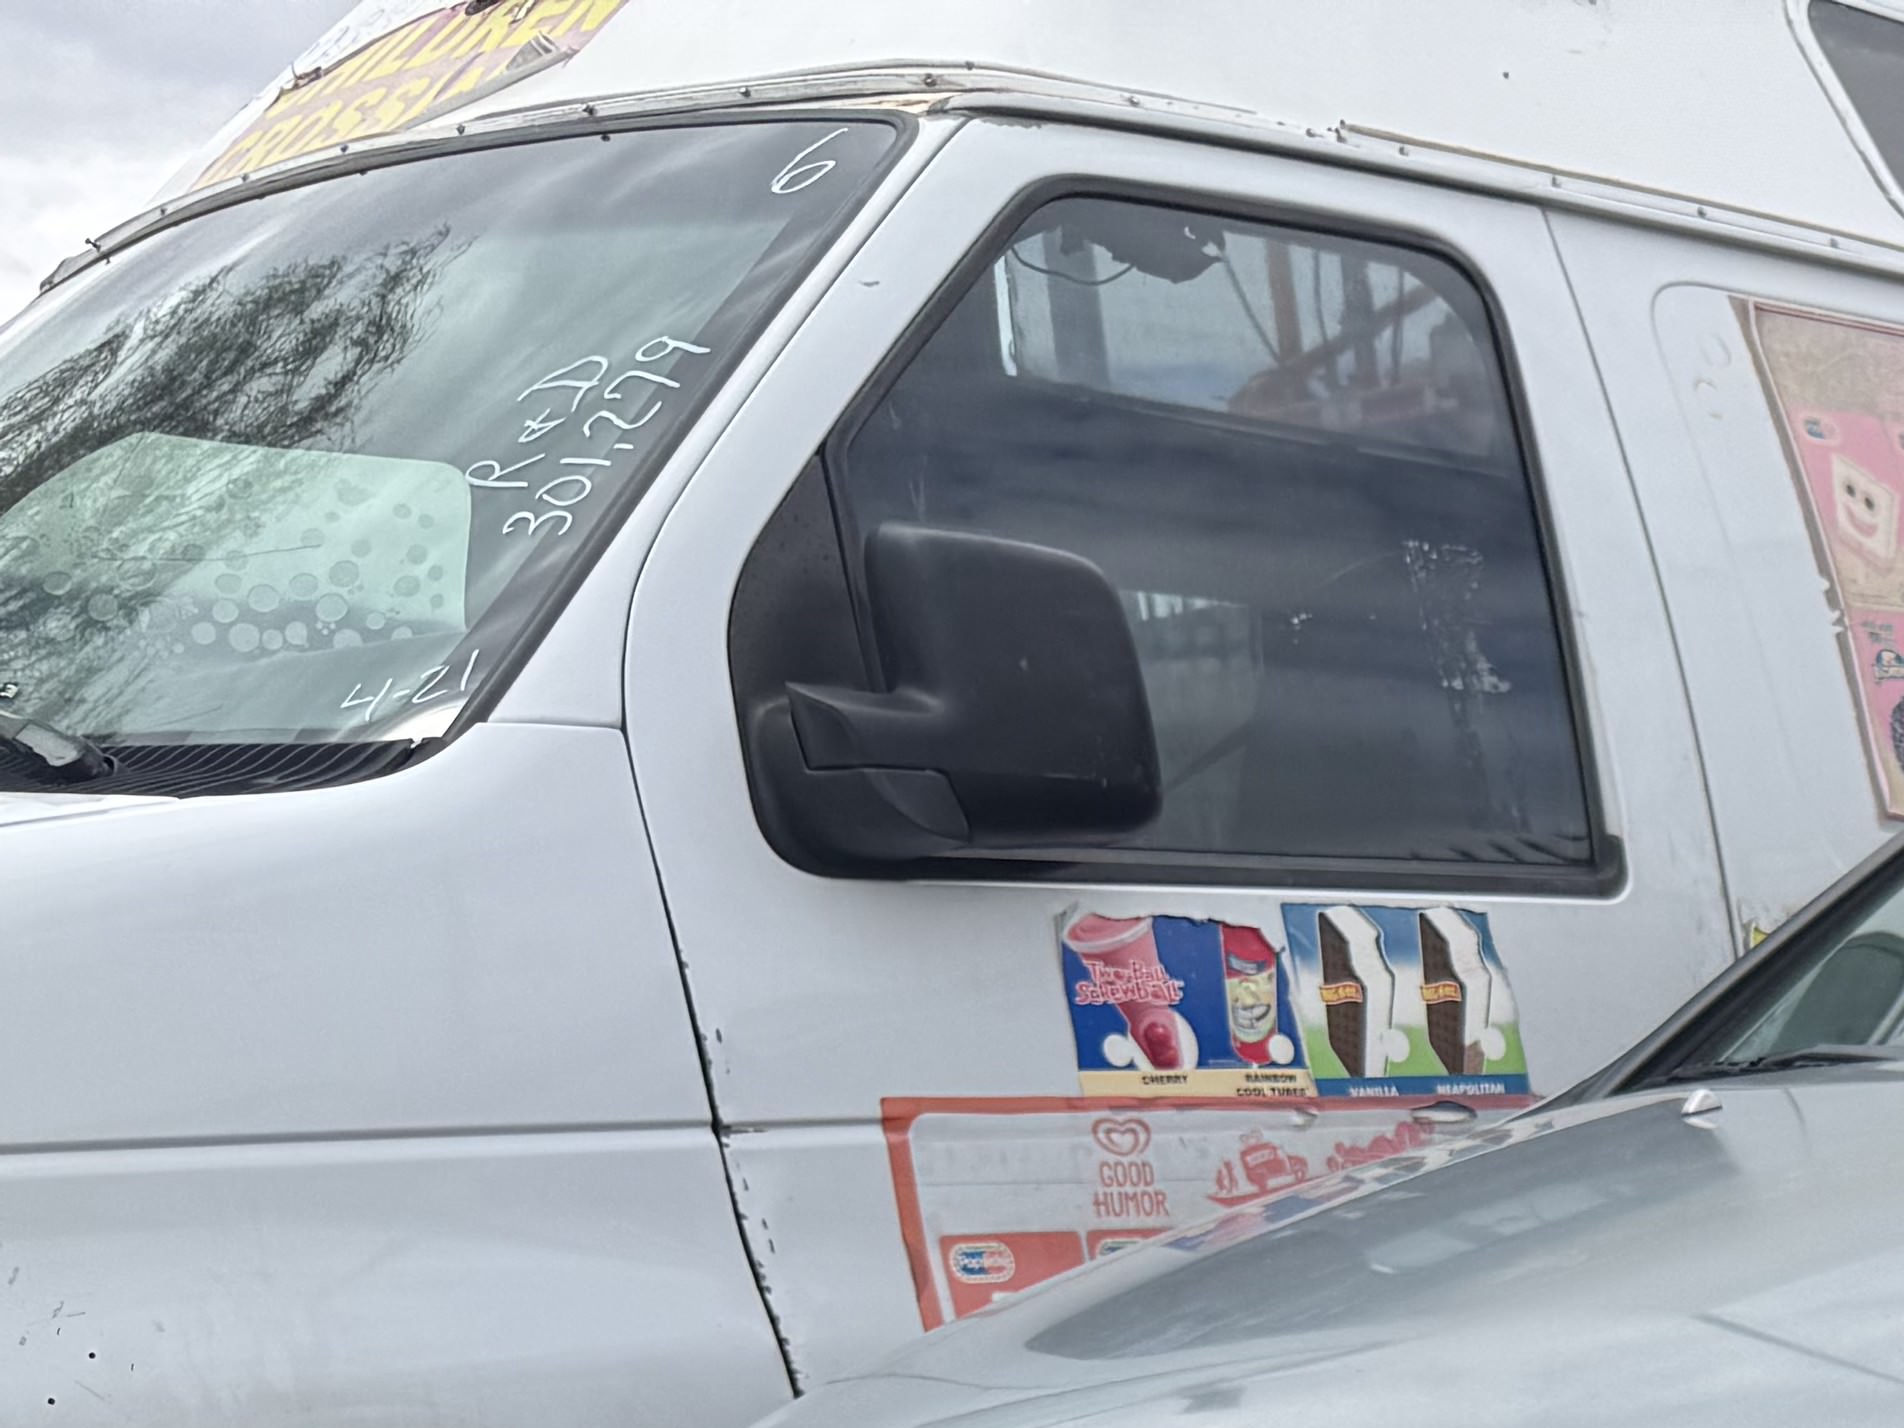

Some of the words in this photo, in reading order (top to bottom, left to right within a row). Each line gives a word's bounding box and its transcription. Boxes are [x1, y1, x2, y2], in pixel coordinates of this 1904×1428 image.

[770, 126, 849, 194] 6
[502, 335, 712, 536] 301,279
[340, 648, 479, 722] 4-21
[1142, 1074, 1189, 1085] CHERRY
[1350, 1085, 1399, 1097] VANILLA
[1437, 1082, 1506, 1095] NEAPOLITAN
[1099, 1160, 1155, 1187] GOOD
[1093, 1191, 1171, 1218] HUMOR
